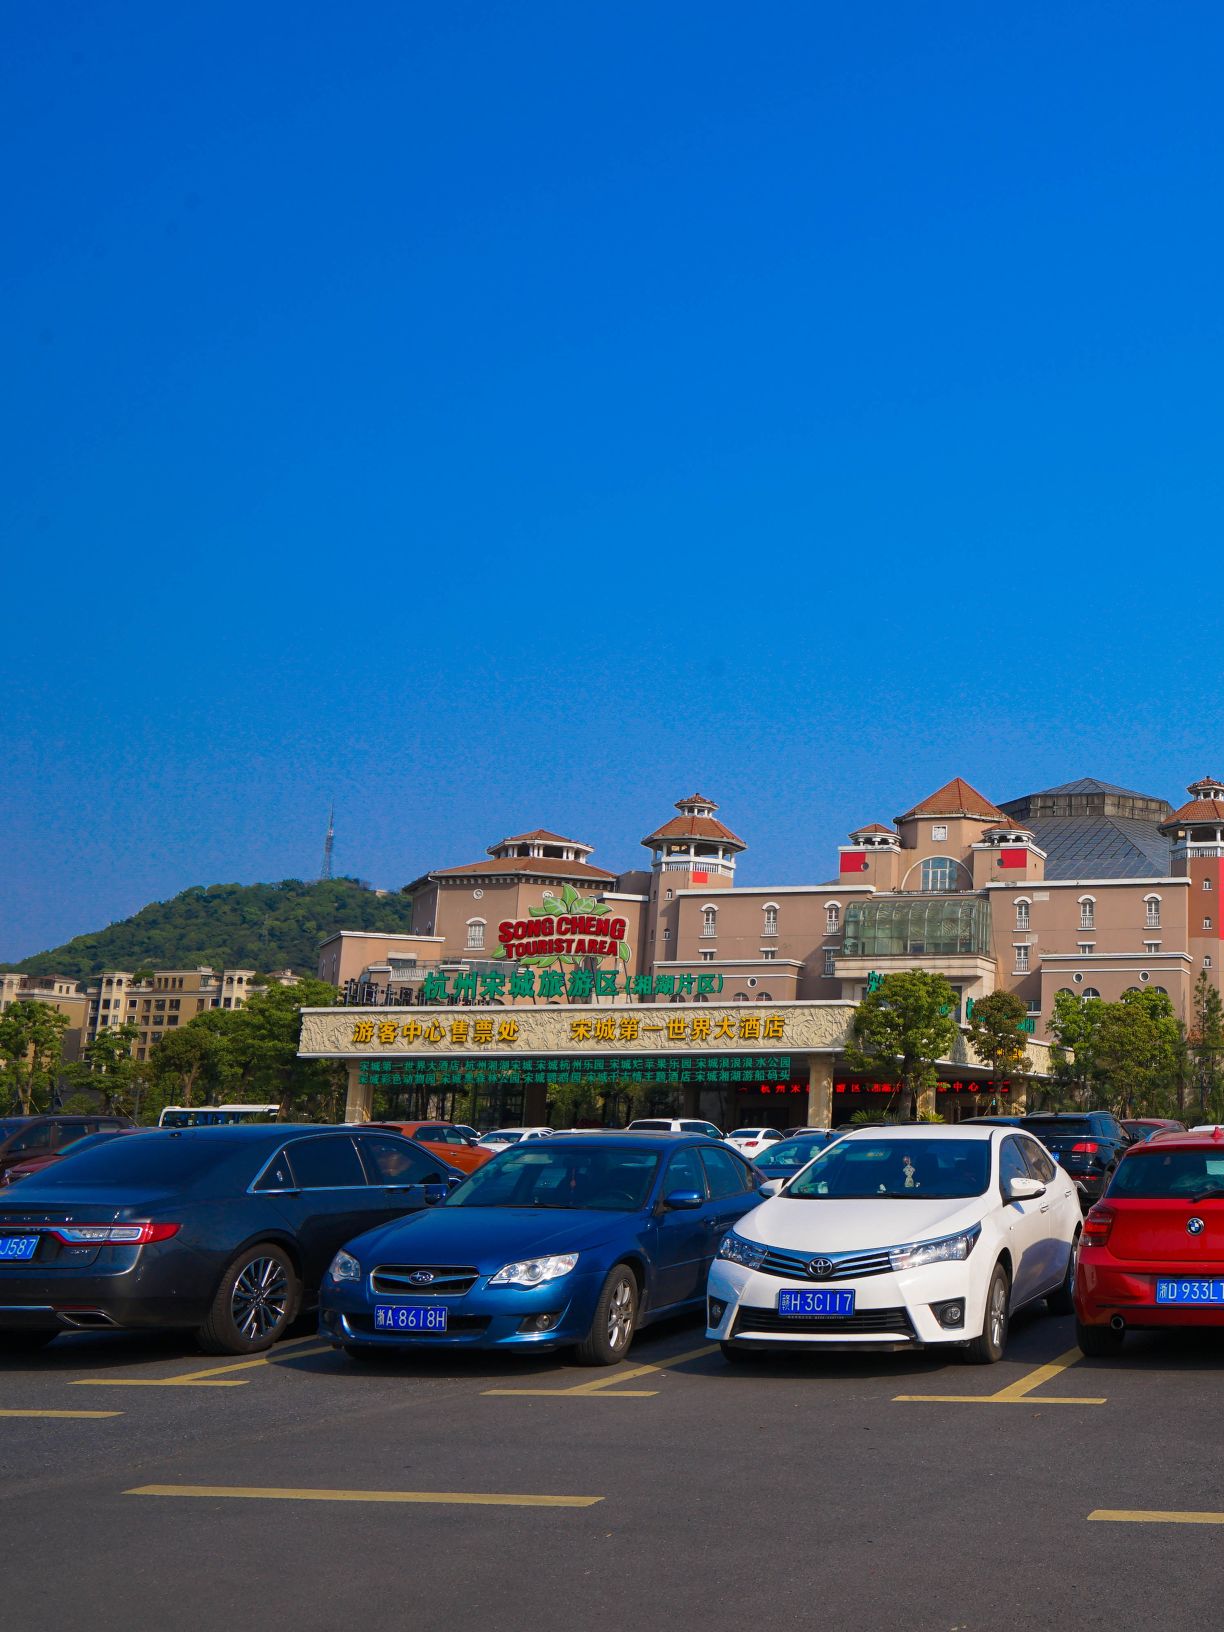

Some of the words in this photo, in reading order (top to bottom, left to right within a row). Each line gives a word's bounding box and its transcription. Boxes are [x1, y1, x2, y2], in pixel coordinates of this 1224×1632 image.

[499, 917, 555, 943] SONG
[556, 915, 626, 940] CHENG
[352, 1019, 520, 1044] 游客中心售票处
[571, 1016, 786, 1041] 宋城第一世界大酒店
[0, 1238, 37, 1256] J587
